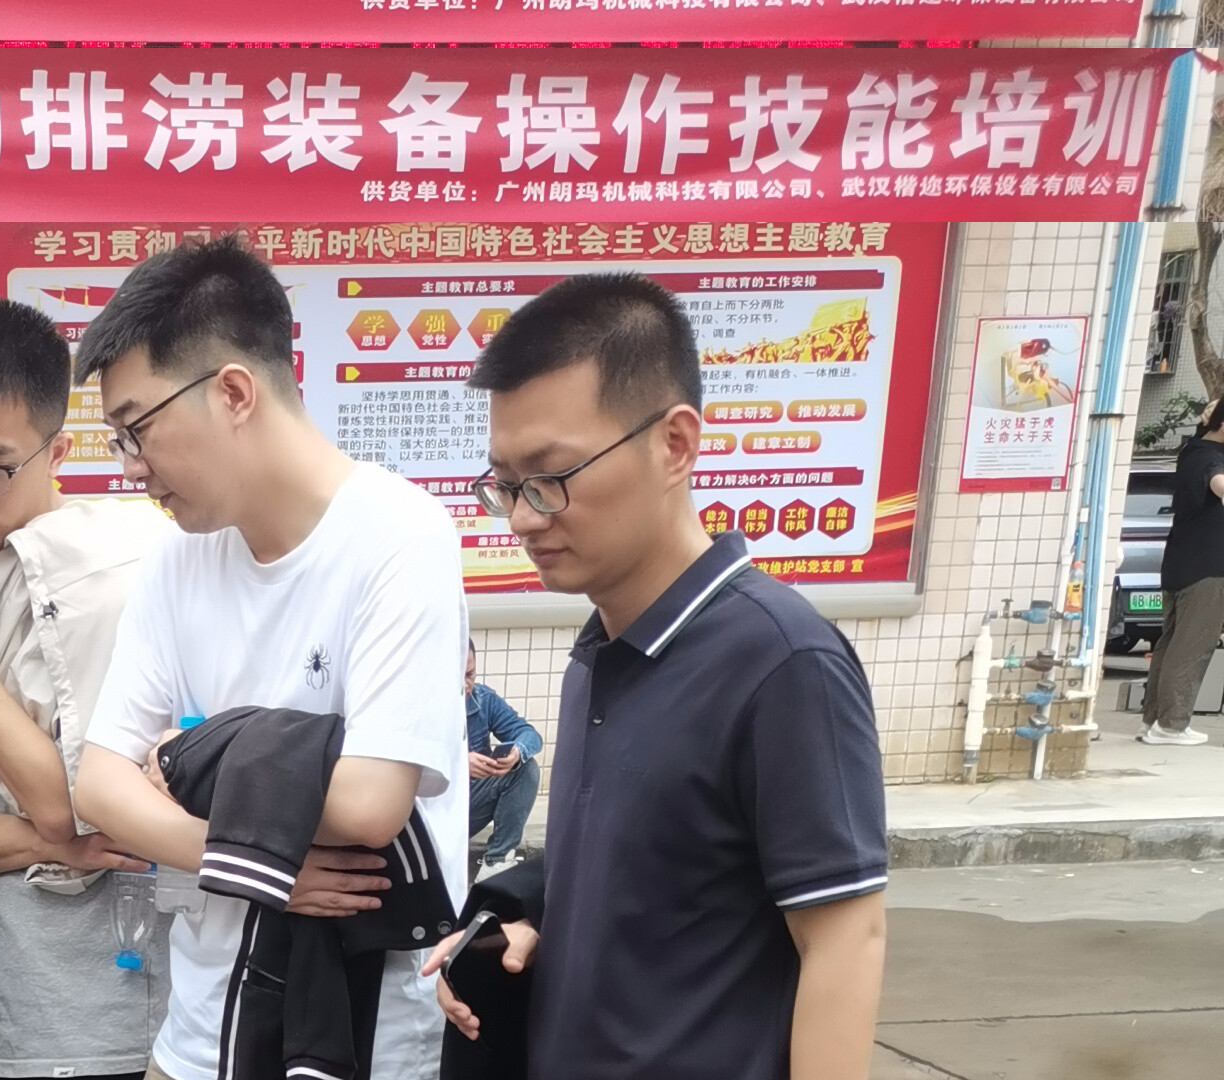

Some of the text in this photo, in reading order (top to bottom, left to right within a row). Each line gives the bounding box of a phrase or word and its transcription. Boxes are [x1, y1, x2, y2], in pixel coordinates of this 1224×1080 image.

[34, 222, 891, 262] 学习贯彻习平新时代中国特色社会主义思想主题教育
[421, 279, 516, 294] 主题教育总要求
[698, 275, 817, 290] 主题教育的工作安排
[361, 335, 386, 347] 思想
[421, 333, 447, 346] 党性
[714, 403, 857, 420] 调查研究 推动发展
[986, 416, 1055, 430] 火灾猛于虎
[752, 435, 811, 450] 建章立制
[983, 430, 1053, 444] 生命大于天
